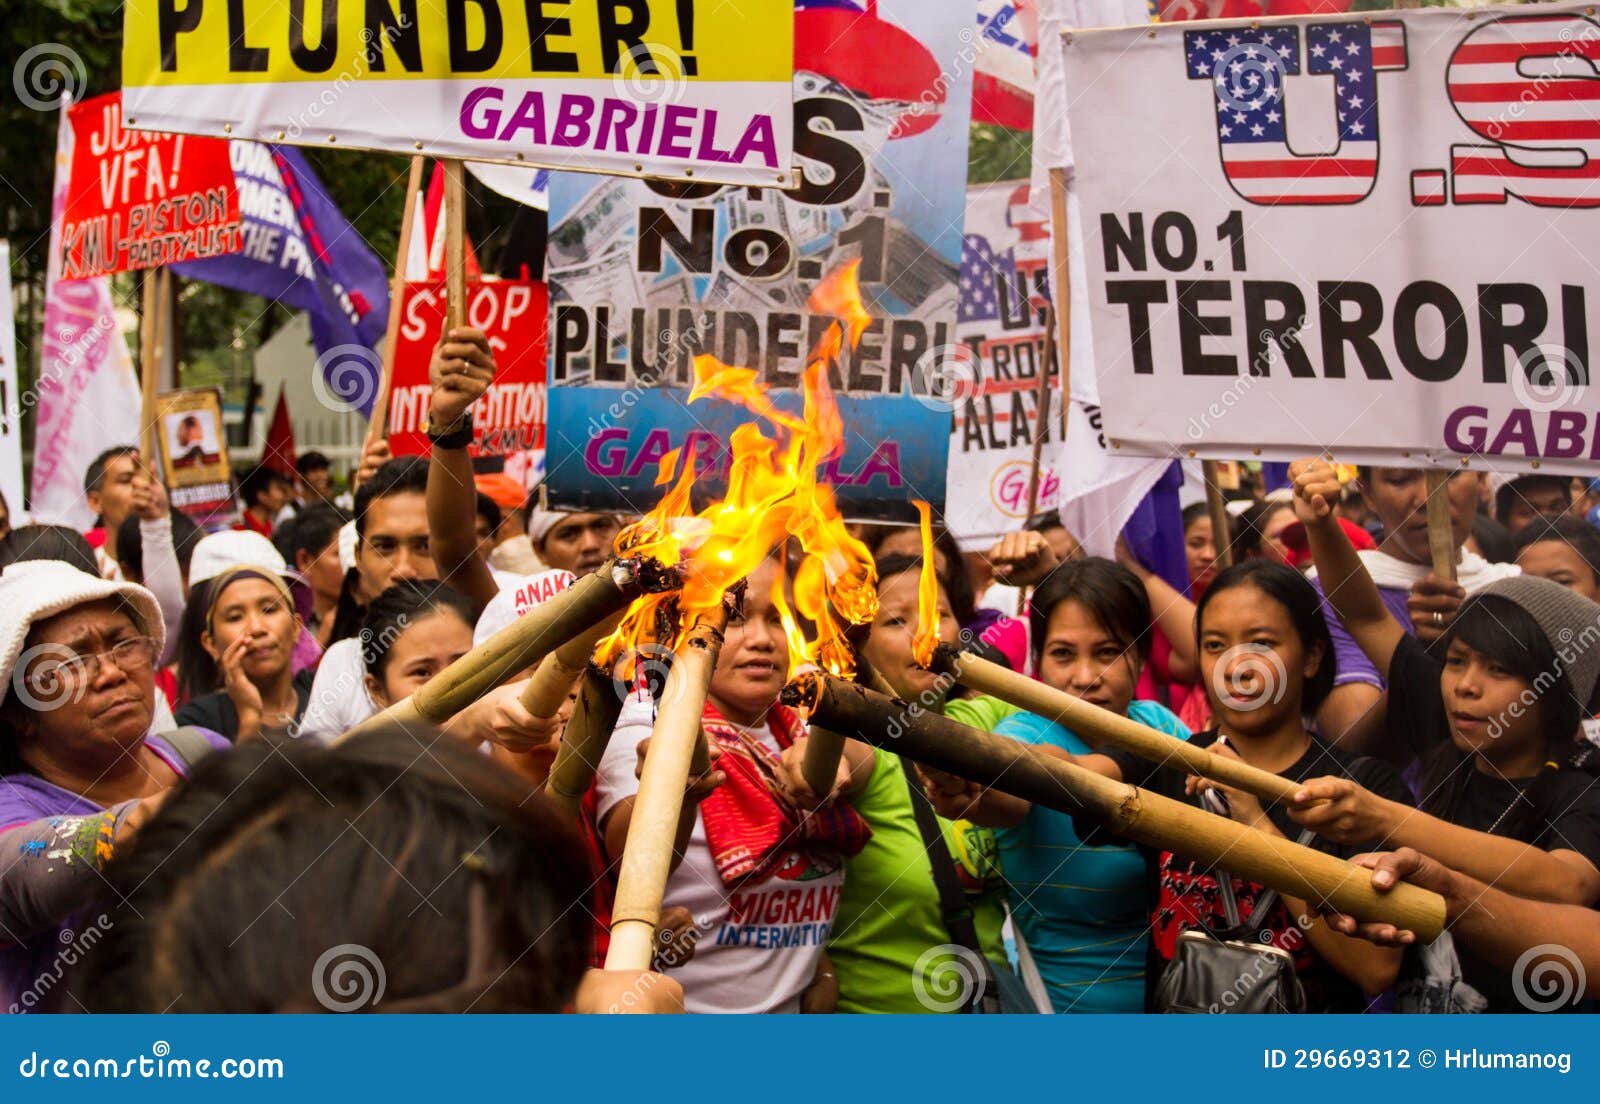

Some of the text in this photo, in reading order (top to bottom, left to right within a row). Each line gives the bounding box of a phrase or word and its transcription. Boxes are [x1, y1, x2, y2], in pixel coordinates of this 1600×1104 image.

[159, 0, 697, 76] PLUNDER!
[460, 86, 779, 169] GABRIELA
[100, 136, 184, 209] VFA!
[129, 185, 229, 238] PISTON
[637, 206, 887, 283] No.1
[1100, 210, 1247, 272] NO.1
[401, 286, 531, 341] SOP
[1105, 279, 1590, 387] TERRORI
[390, 382, 547, 435] INTENTION
[1444, 405, 1600, 460] GAB
